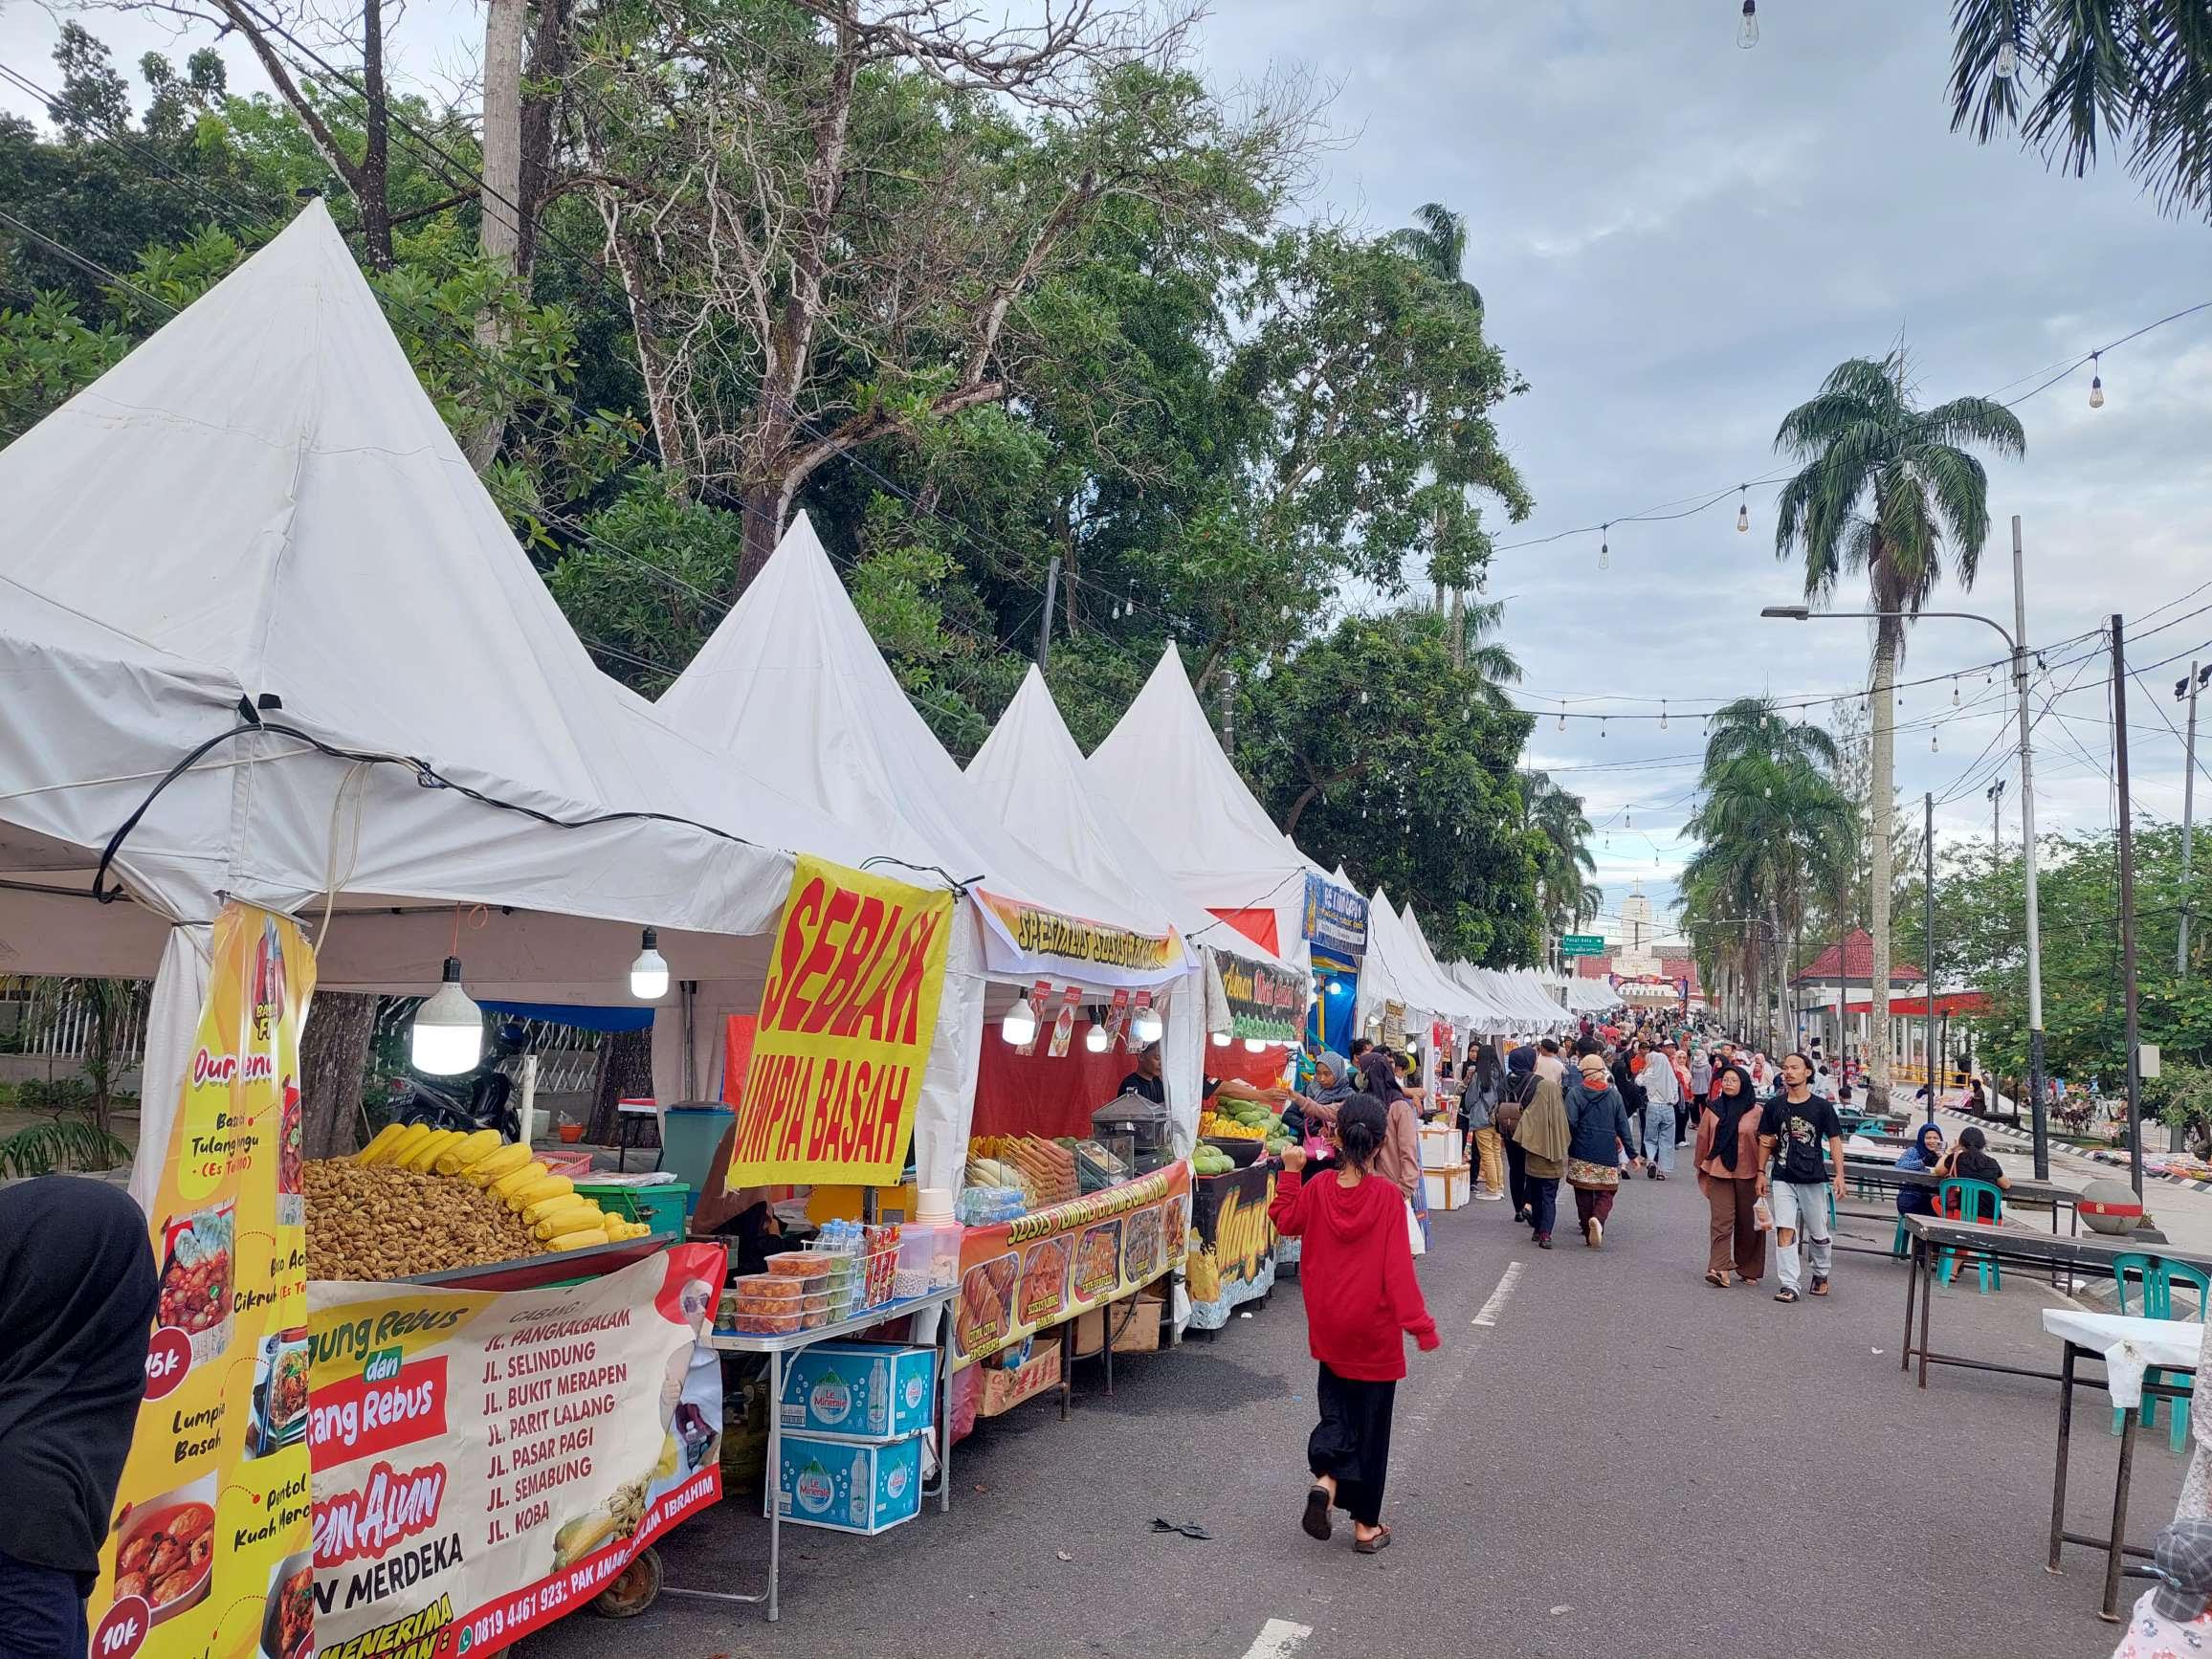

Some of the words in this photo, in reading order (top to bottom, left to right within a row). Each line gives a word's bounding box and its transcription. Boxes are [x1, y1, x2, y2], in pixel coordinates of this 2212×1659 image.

[761, 876, 941, 1046] SEBLAK
[193, 1048, 236, 1083] Our
[807, 1058, 911, 1164] BASAH
[375, 1308, 469, 1345] Rebus
[366, 1351, 398, 1382] dan
[482, 1360, 502, 1384] JL.
[507, 1340, 596, 1379] SELINDUNG
[309, 1401, 358, 1447] ang
[363, 1380, 433, 1432] Rebus
[482, 1392, 502, 1416] JL.
[508, 1378, 552, 1409] BUKIT
[557, 1362, 627, 1397] MERAPEN
[174, 1428, 221, 1464] Basah
[488, 1423, 505, 1448] JL.
[509, 1408, 549, 1440] PARIT
[554, 1393, 615, 1427] LALANG
[487, 1454, 508, 1479] JL.
[513, 1437, 556, 1471] PASAR
[560, 1427, 593, 1455] PAGI
[486, 1487, 510, 1513] JL.
[515, 1456, 592, 1502] SEMABUNG
[233, 1517, 276, 1553] Kuah
[487, 1520, 510, 1545] JL.
[515, 1500, 549, 1535] KOBA
[344, 1533, 464, 1609] MERDEKA
[475, 1610, 504, 1646] 0819
[507, 1591, 537, 1625] 4461
[570, 1564, 593, 1595] PAK
[664, 1475, 714, 1520] IBRAHIM
[101, 1616, 139, 1655] 10k
[317, 1592, 453, 1659] MENERIMA
